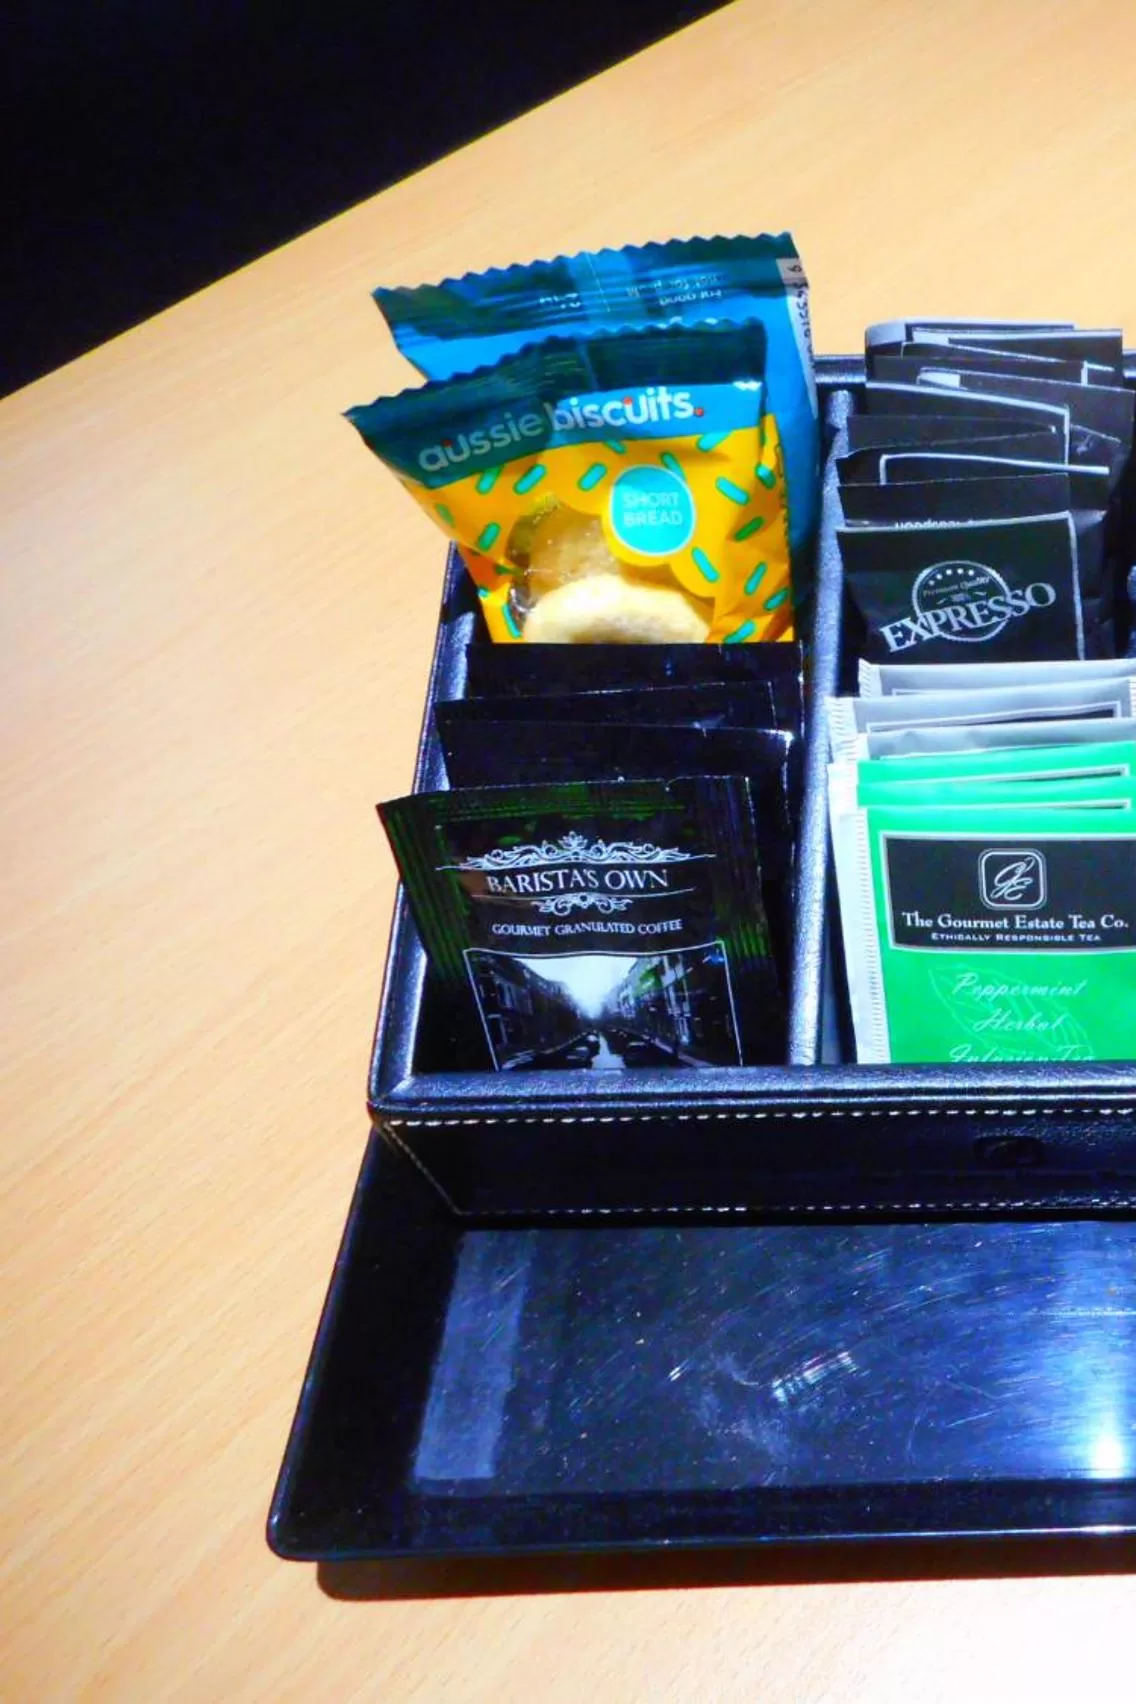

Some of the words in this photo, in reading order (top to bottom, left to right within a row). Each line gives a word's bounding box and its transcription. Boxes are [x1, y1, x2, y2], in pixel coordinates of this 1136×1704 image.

[418, 412, 545, 472] aussie
[623, 492, 680, 509] SHORT
[623, 510, 684, 528] BREAD
[880, 583, 1056, 653] EXPRESSO
[486, 868, 599, 893] BARISTA'S
[605, 869, 669, 891] OWN
[492, 923, 551, 937] GOURMET
[555, 920, 635, 936] GRANULATED
[638, 918, 683, 935] COFFEE
[902, 911, 933, 929] The
[937, 913, 1009, 930] Gourmet
[1014, 914, 1065, 930] Estate
[1068, 913, 1096, 930] Tea
[1100, 913, 1129, 929] Co.
[951, 972, 1088, 1001] Peppermint
[972, 1007, 1069, 1033] Herbal
